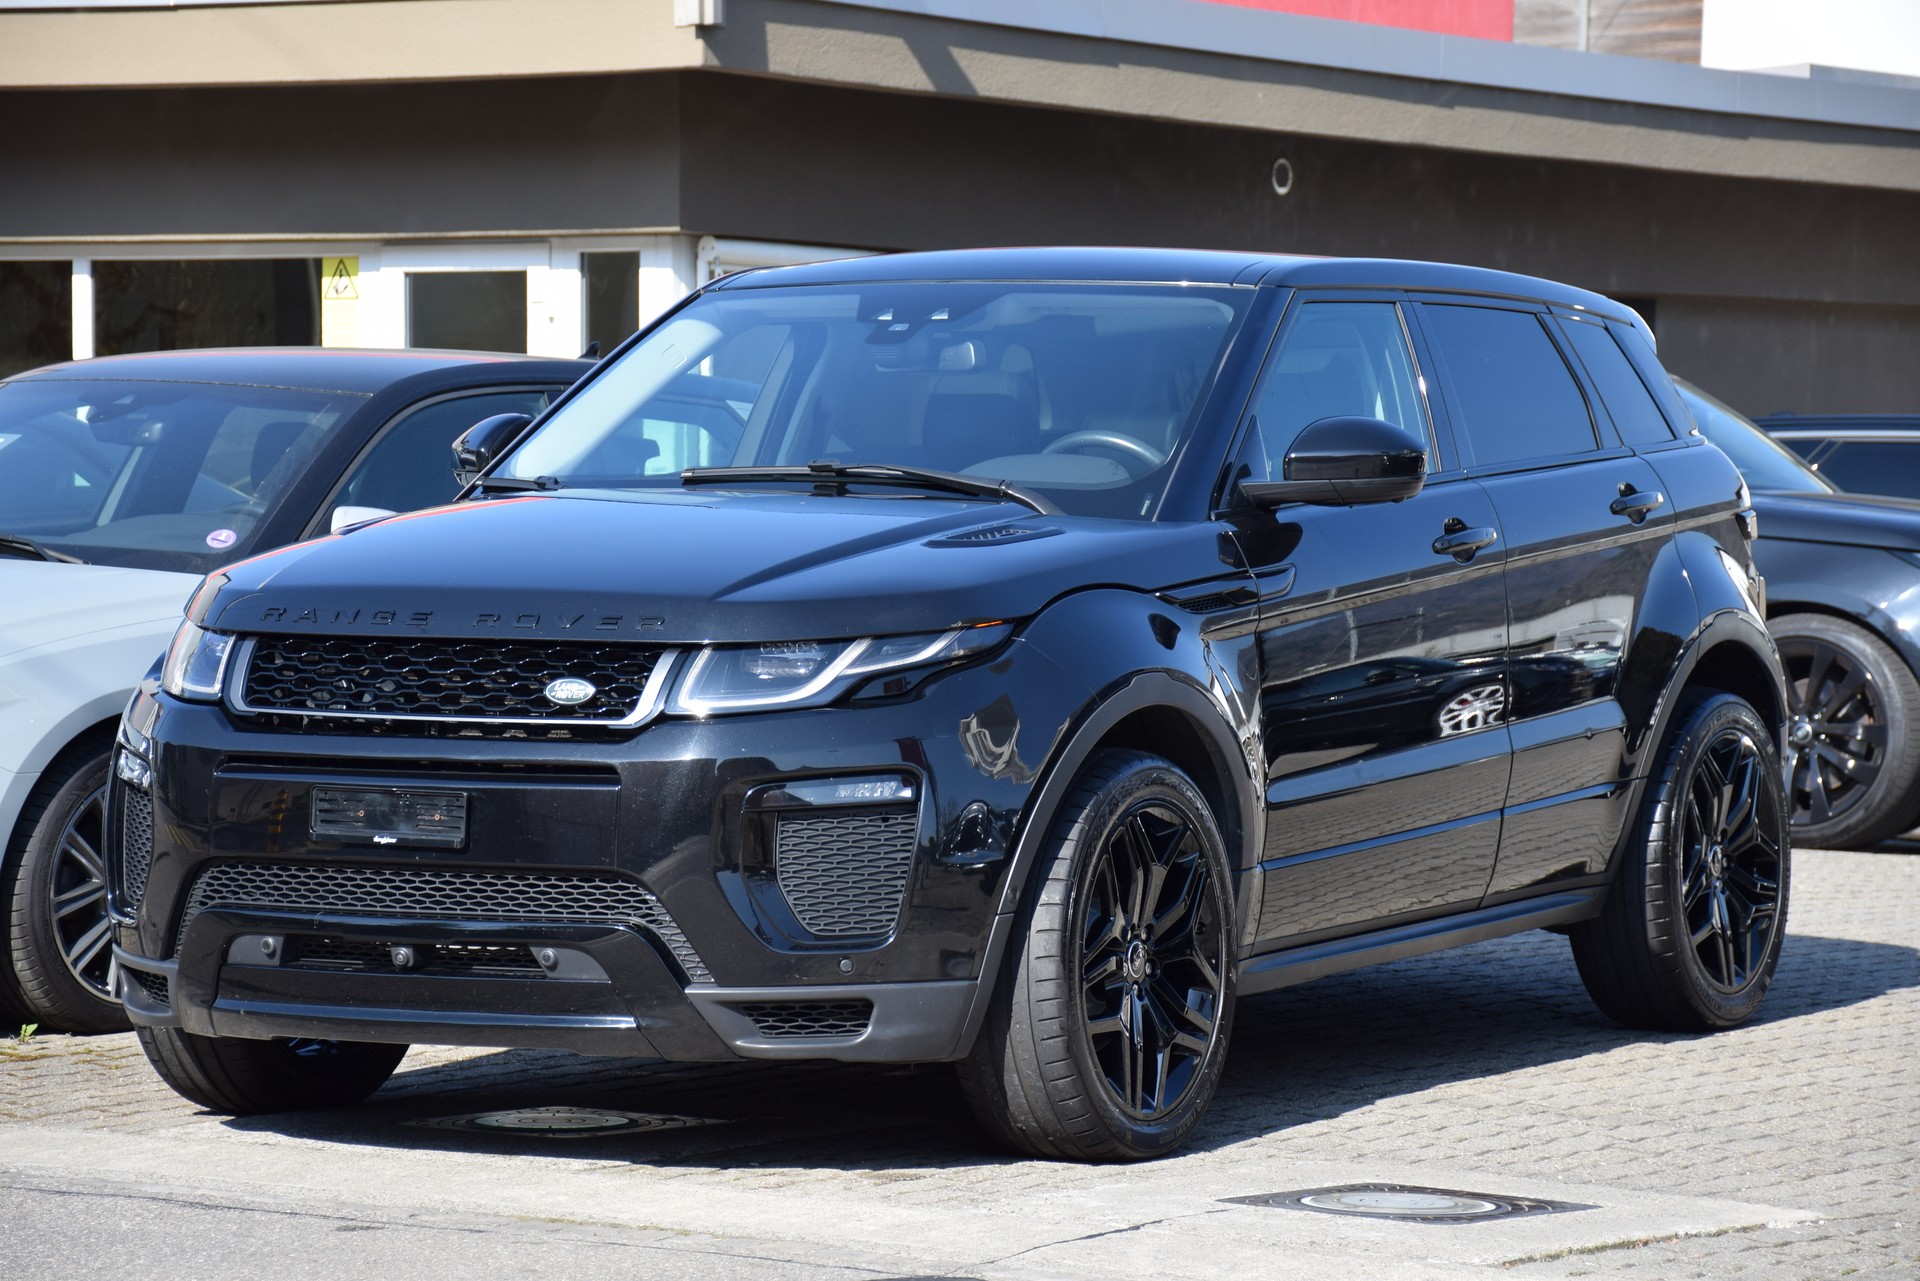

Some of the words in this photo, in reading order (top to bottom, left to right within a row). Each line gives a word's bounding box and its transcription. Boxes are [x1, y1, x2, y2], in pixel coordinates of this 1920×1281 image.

[259, 606, 433, 627] RANGE
[471, 613, 667, 632] ROVER
[554, 683, 580, 691] LAND
[555, 690, 586, 699] ROVER
